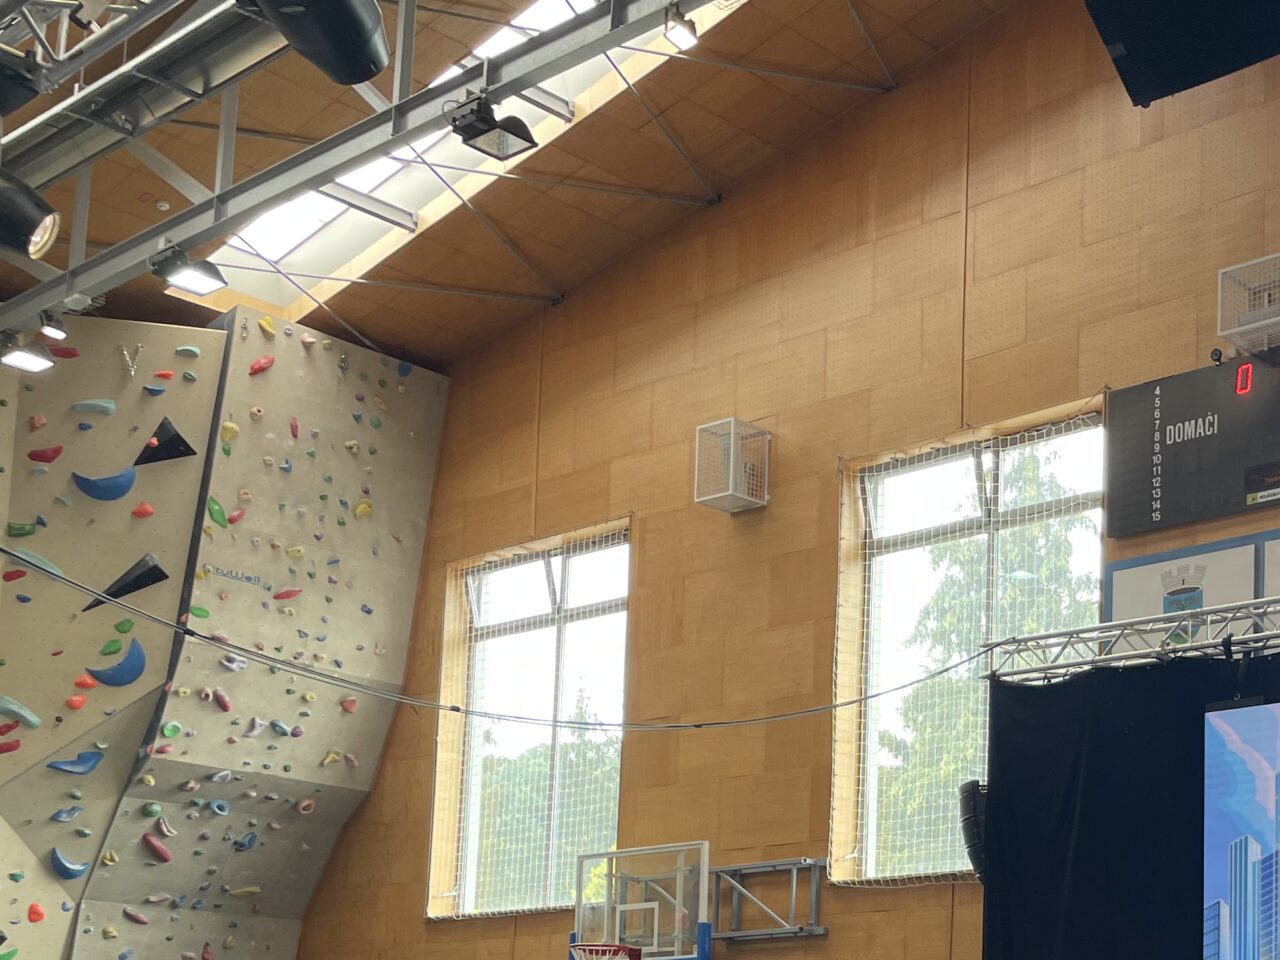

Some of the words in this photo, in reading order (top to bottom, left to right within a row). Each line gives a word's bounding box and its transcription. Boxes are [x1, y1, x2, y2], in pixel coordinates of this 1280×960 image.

[1236, 363, 1252, 394] 0
[1154, 385, 1161, 396] 4
[1154, 396, 1161, 407] 5
[1154, 408, 1161, 419] 6
[1154, 419, 1161, 430] 7
[1153, 431, 1161, 442] 8
[1153, 443, 1161, 453] 9
[1151, 454, 1162, 465] 10
[1152, 465, 1162, 476] 11
[1151, 477, 1162, 488] 12
[1151, 488, 1162, 499] 13
[1151, 500, 1162, 511] 14
[1151, 511, 1162, 522] 15
